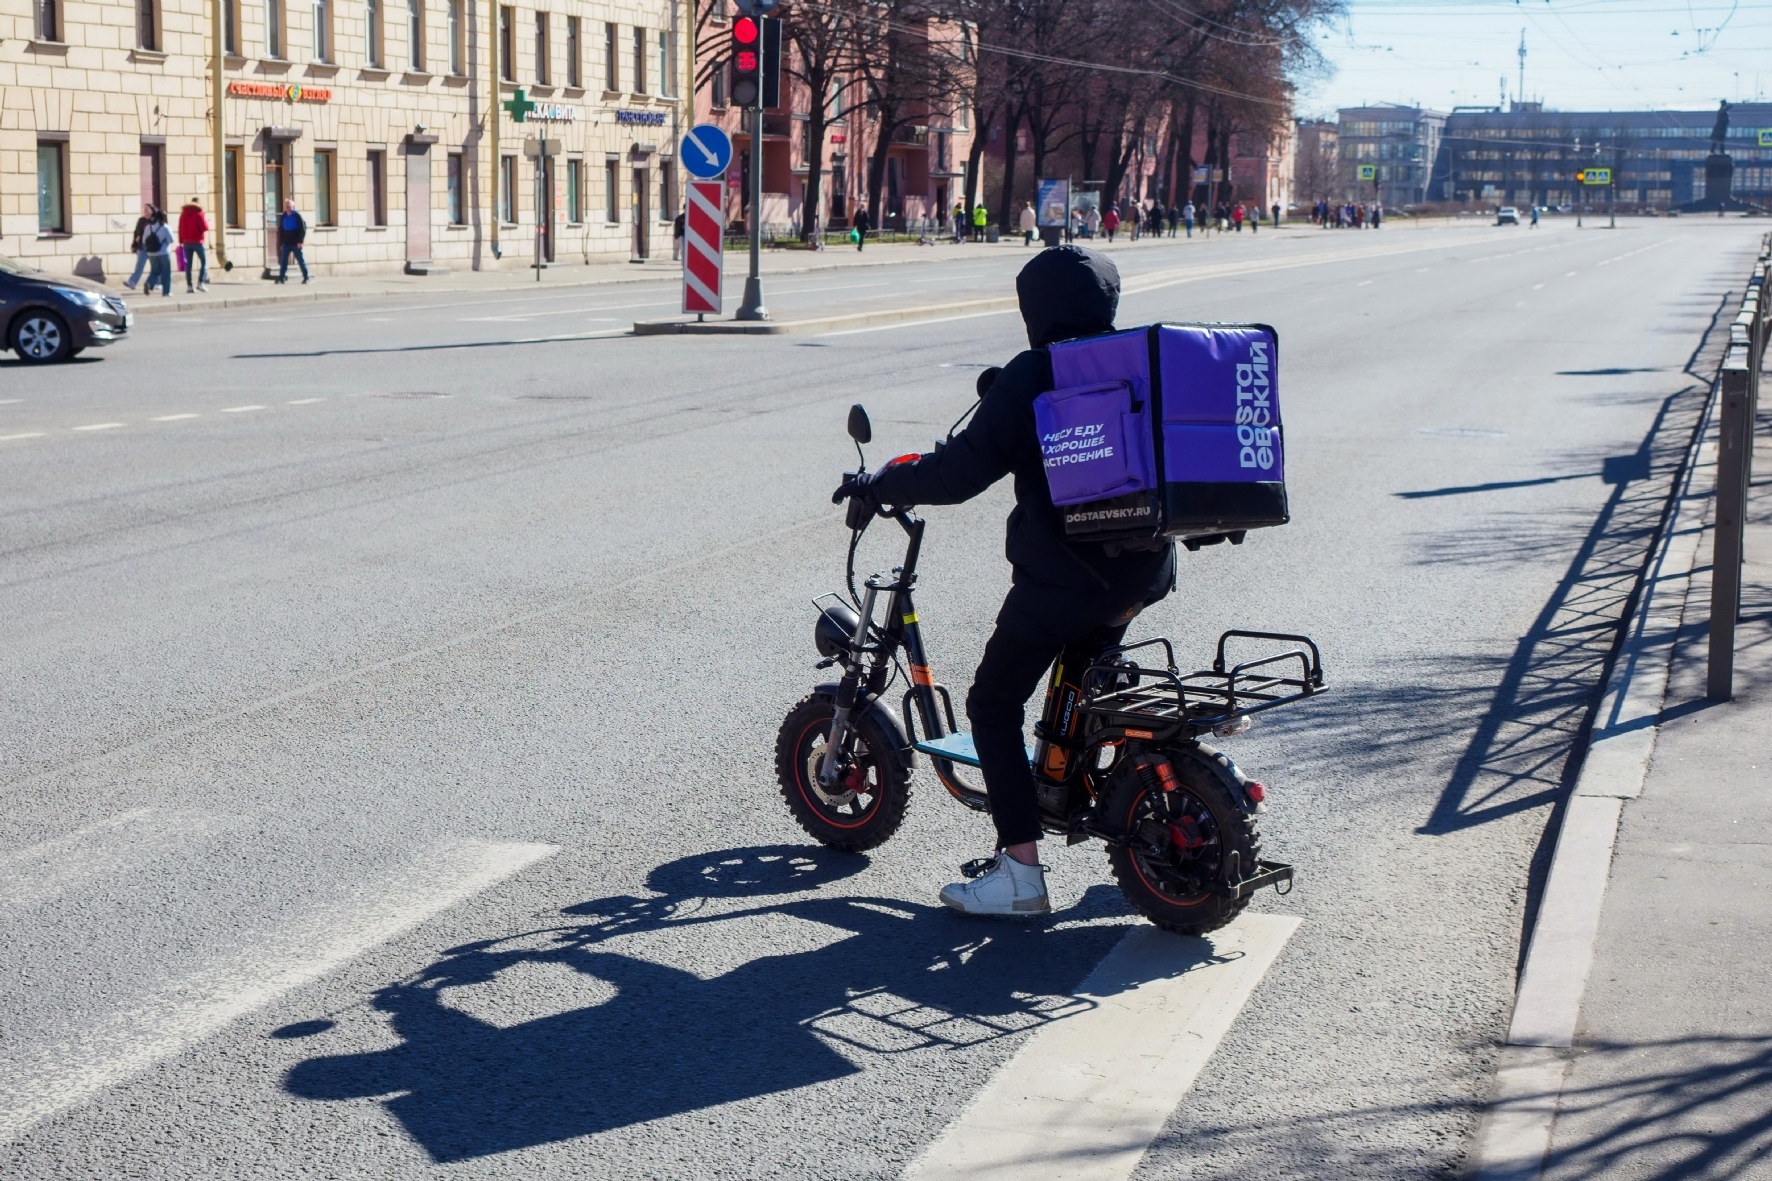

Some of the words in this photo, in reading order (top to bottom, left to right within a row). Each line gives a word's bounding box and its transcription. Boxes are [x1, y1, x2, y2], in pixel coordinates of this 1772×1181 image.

[1043, 427, 1073, 442] НЕСУ
[1074, 424, 1104, 437] ЕДУ
[1046, 435, 1106, 455] ХОРОШЕЕ
[1043, 446, 1114, 468] АСТРОЕНИЕ
[1066, 506, 1151, 523] DOSTAEVSKY.RU
